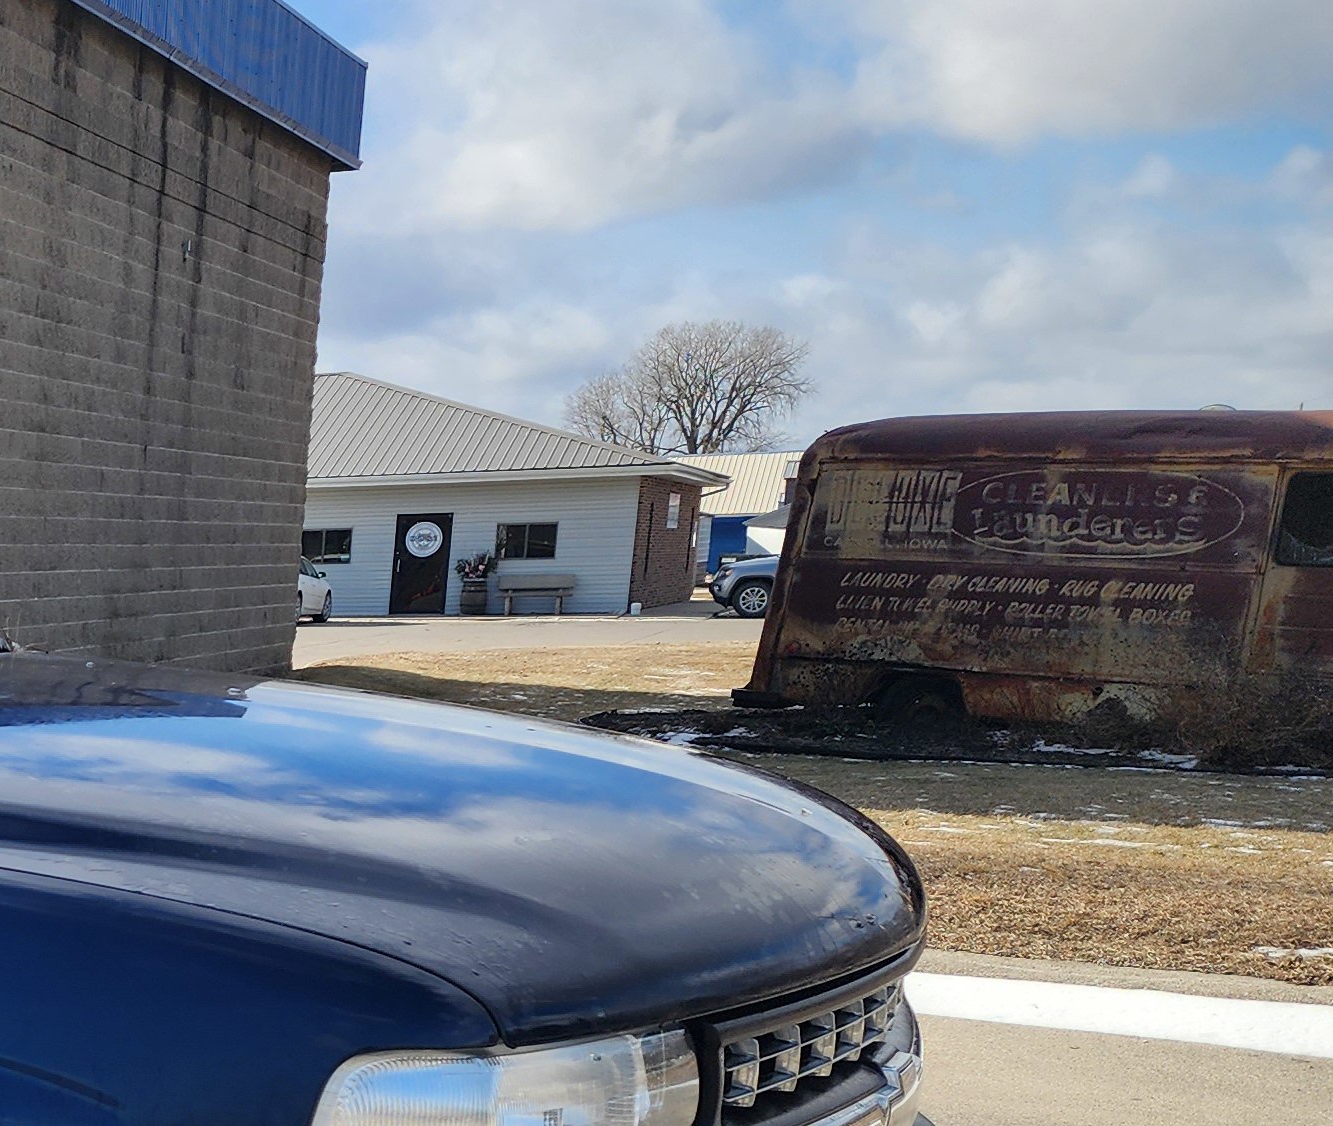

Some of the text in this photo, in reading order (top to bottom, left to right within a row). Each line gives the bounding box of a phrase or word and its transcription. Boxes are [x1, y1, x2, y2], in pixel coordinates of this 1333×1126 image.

[840, 571, 1195, 601] LAUNDRY DRY CLEANING RUG CLEANING
